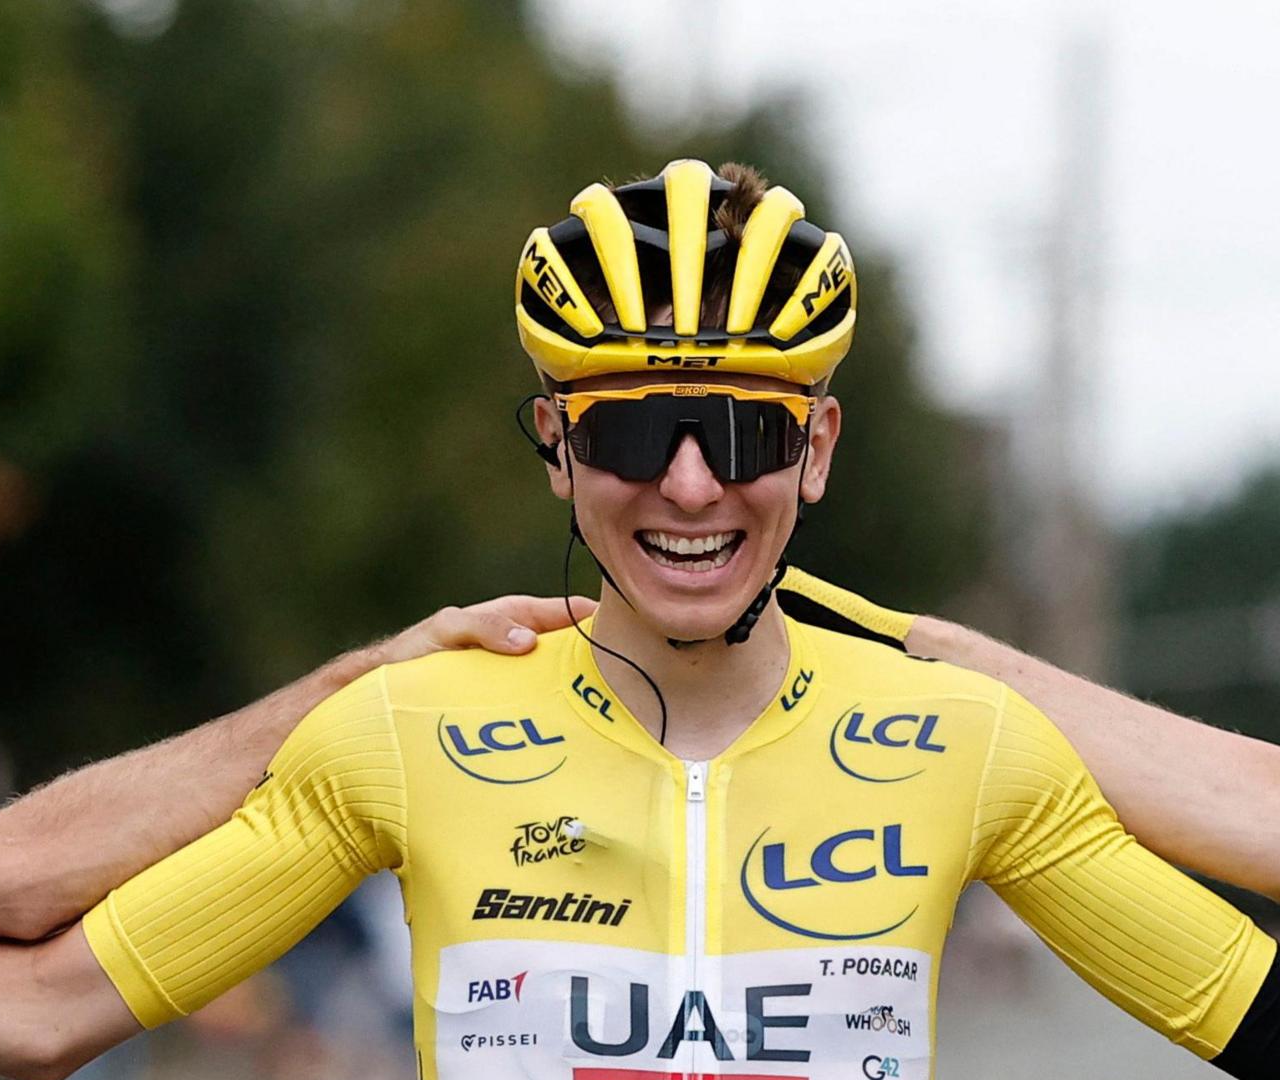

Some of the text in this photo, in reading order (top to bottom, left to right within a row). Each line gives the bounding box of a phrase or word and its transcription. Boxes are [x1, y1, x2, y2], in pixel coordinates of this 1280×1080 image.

[525, 242, 578, 311] MET
[801, 244, 847, 317] MET
[646, 355, 726, 369] MET
[571, 673, 614, 723] LCL
[780, 668, 813, 712] LCL
[445, 718, 565, 757] LCL
[843, 712, 947, 753] LCL
[762, 823, 929, 890] LCL
[472, 888, 633, 927] Santini
[819, 957, 918, 982] T. POGACAR
[467, 978, 512, 1004] FAB
[570, 975, 813, 1063] UAE
[478, 1033, 538, 1049] PISSEI
